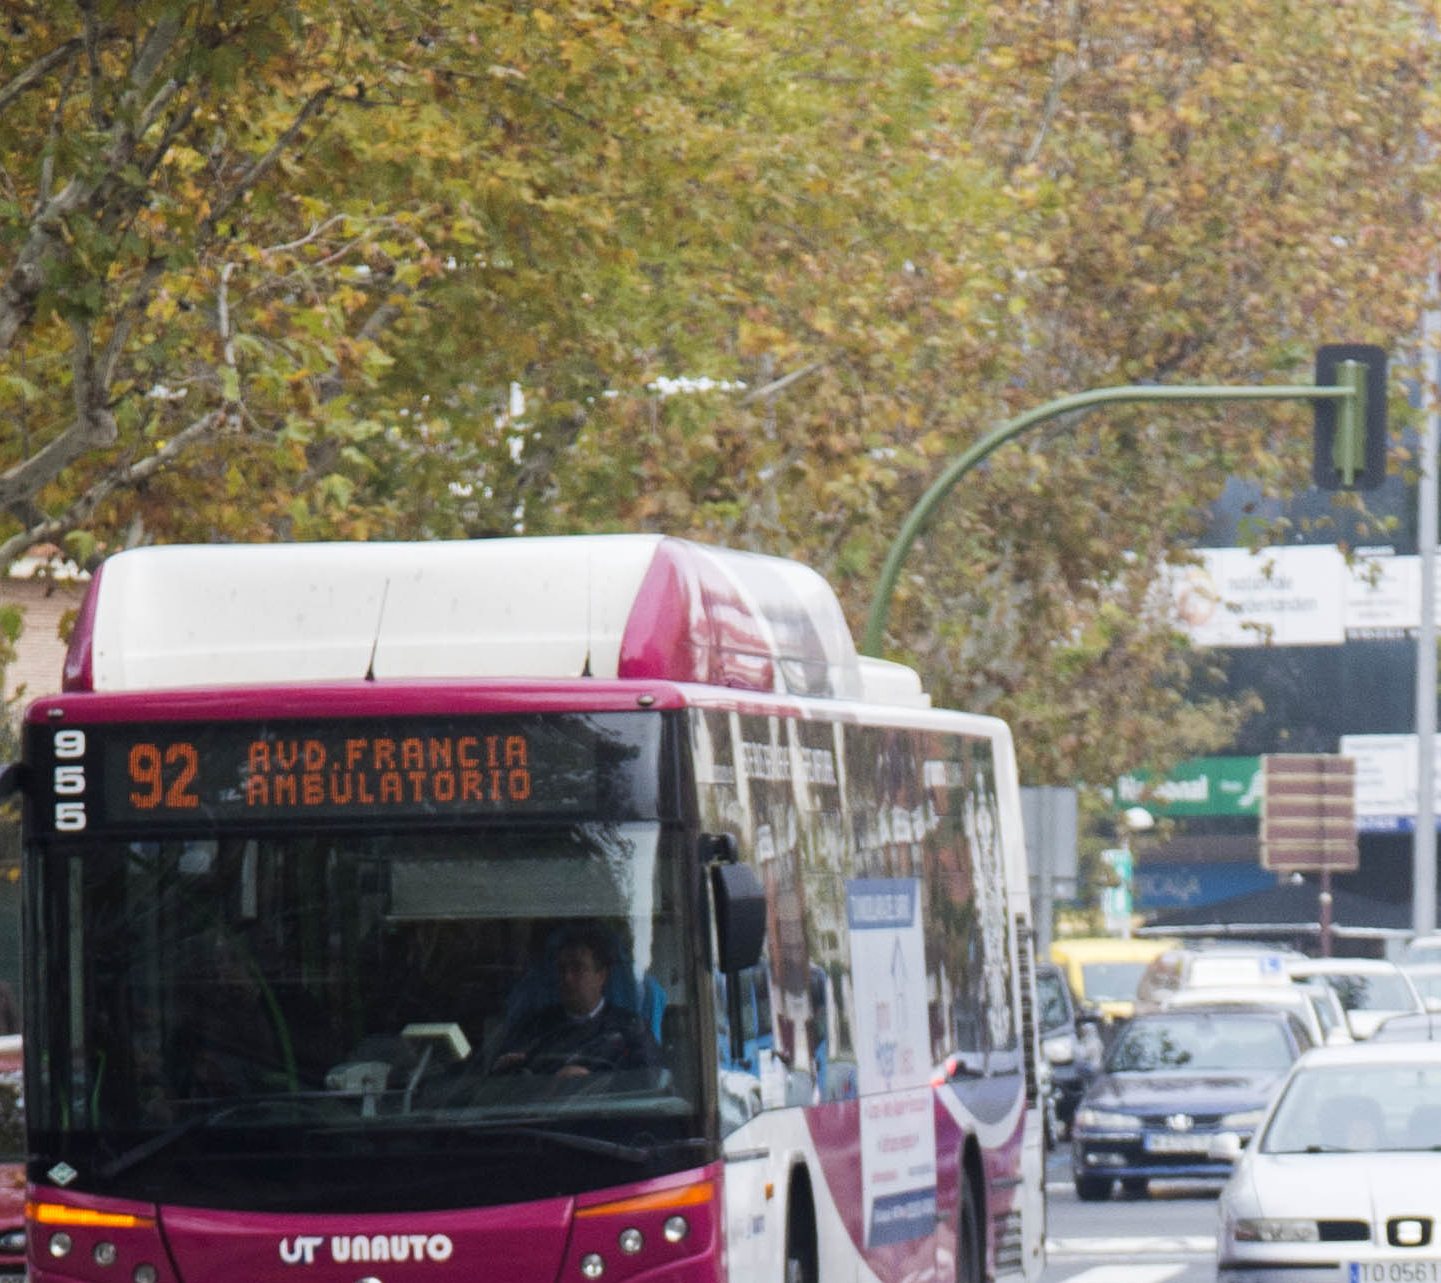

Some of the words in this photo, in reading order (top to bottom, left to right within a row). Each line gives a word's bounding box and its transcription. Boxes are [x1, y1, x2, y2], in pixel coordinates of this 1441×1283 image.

[54, 729, 87, 831] 955
[128, 742, 199, 809] 92
[247, 768, 531, 806] AMBULATORIO
[330, 1234, 453, 1262] UNAUTO
[1361, 1263, 1384, 1282] TO
[1390, 1263, 1438, 1282] 0561
